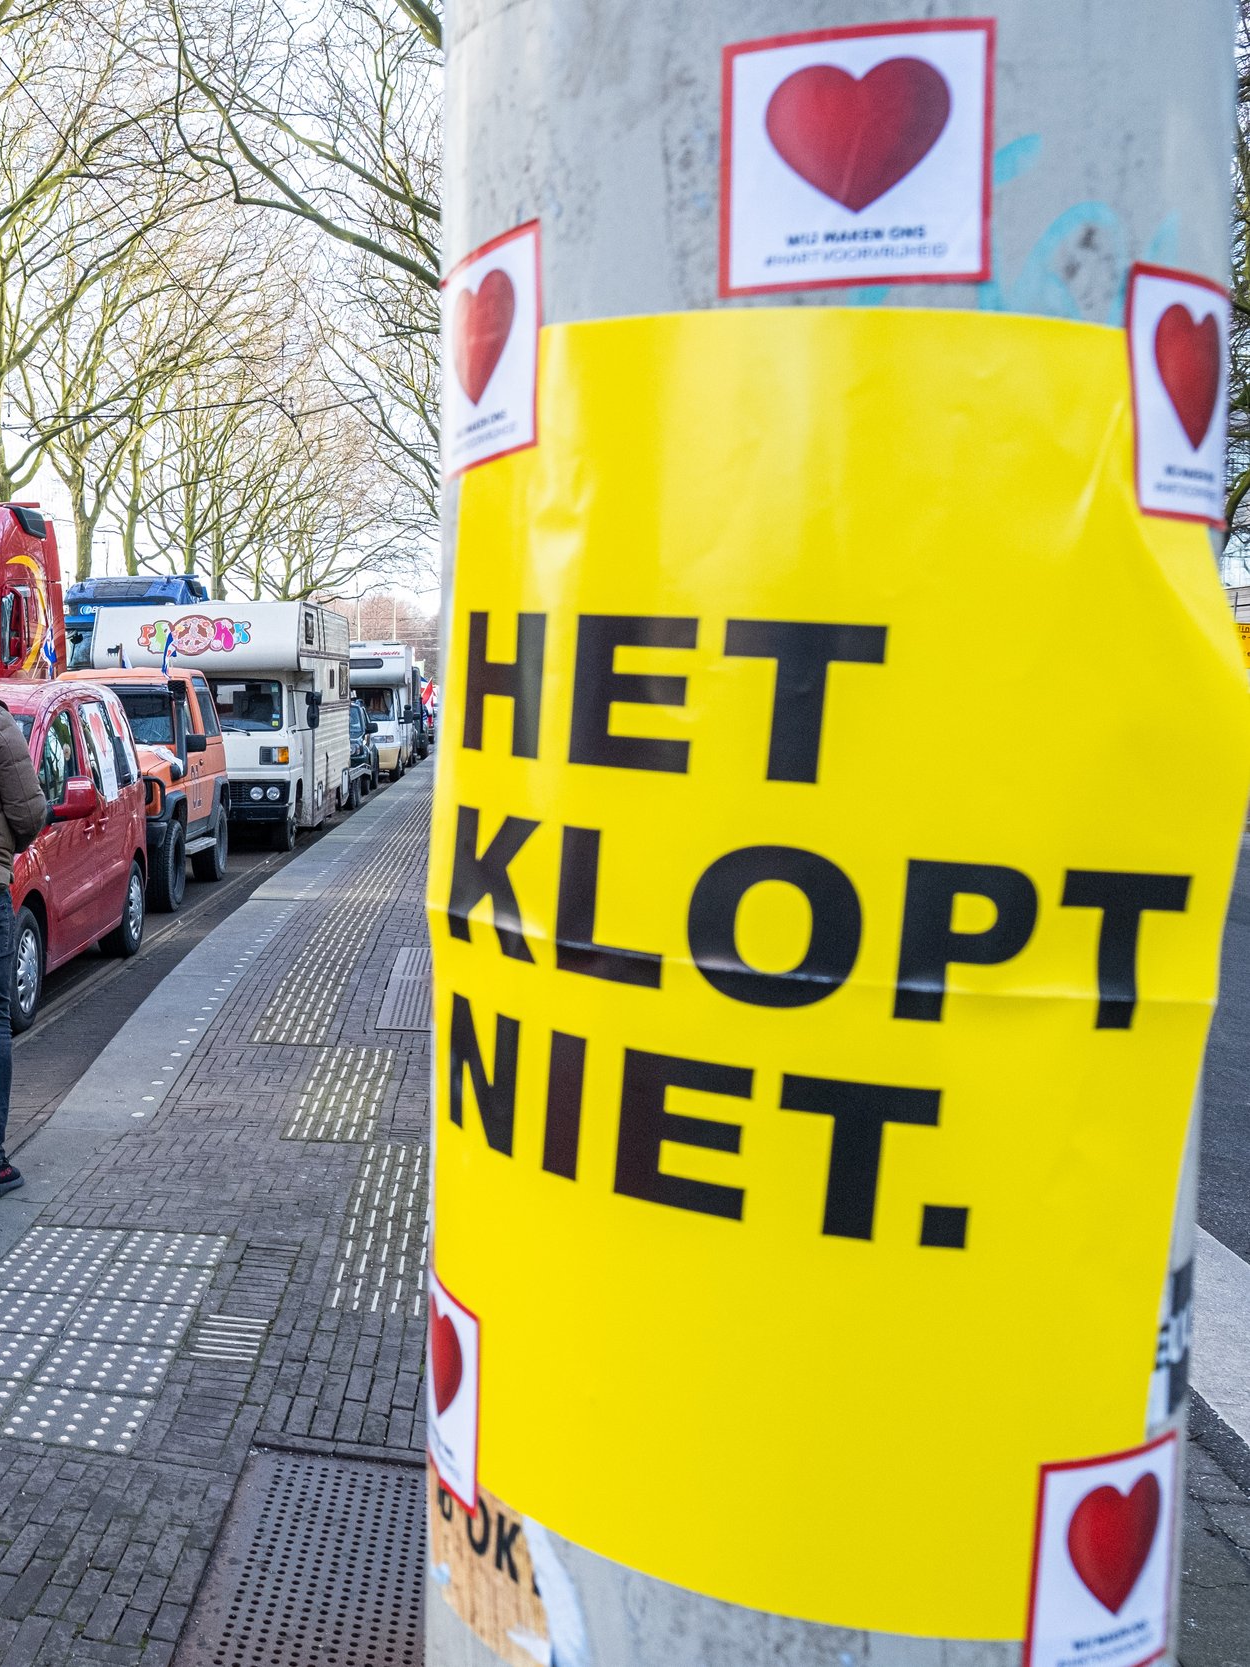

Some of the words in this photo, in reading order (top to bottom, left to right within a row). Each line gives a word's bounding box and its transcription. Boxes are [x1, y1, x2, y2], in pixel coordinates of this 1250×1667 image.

[462, 611, 888, 785] HET
[446, 804, 1194, 1030] KLOPT
[448, 991, 971, 1249] NIET.
